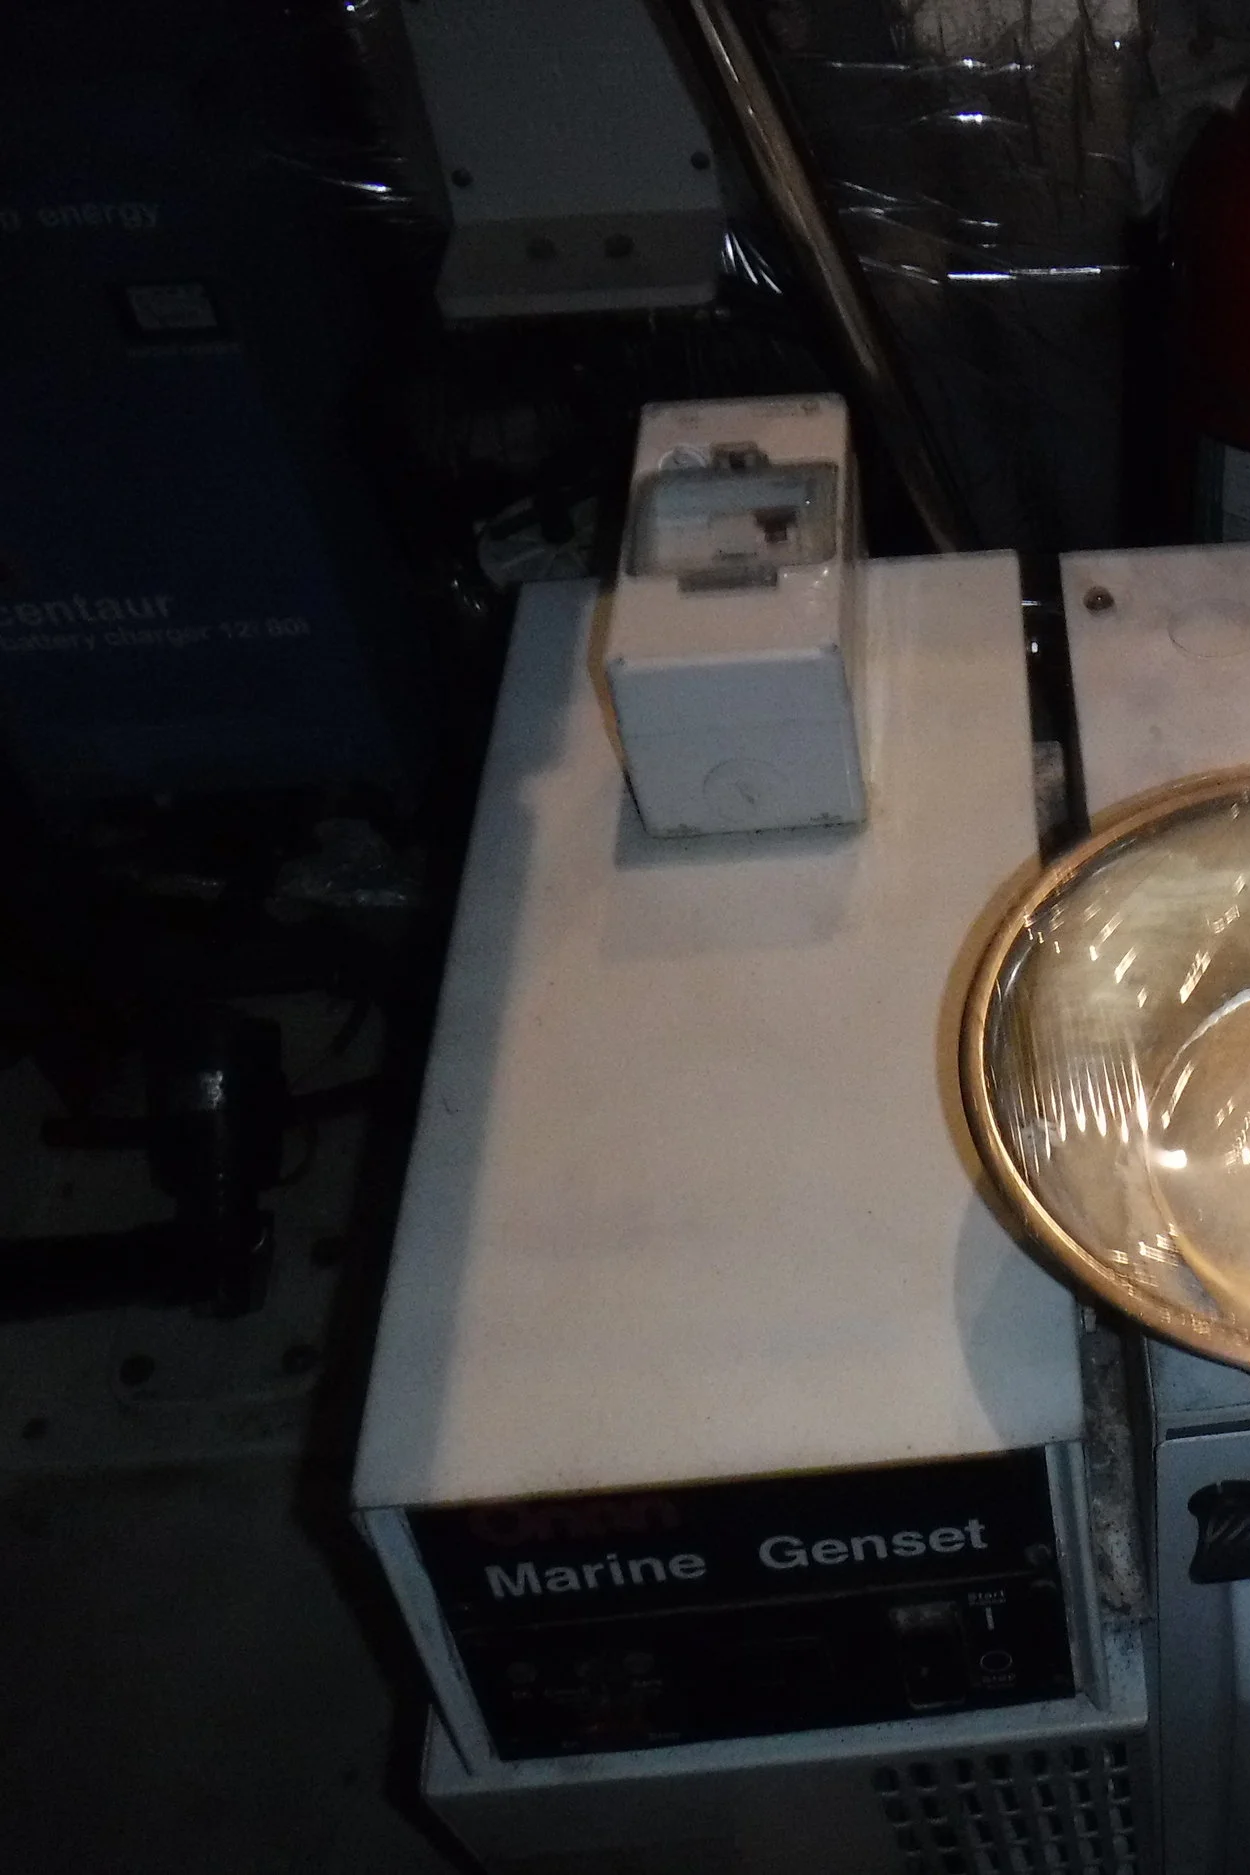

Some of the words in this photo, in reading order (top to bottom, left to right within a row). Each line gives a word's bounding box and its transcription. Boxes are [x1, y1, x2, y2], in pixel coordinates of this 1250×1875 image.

[37, 201, 161, 230] energy
[483, 1551, 708, 1601] Marine
[758, 1515, 989, 1572] Genset
